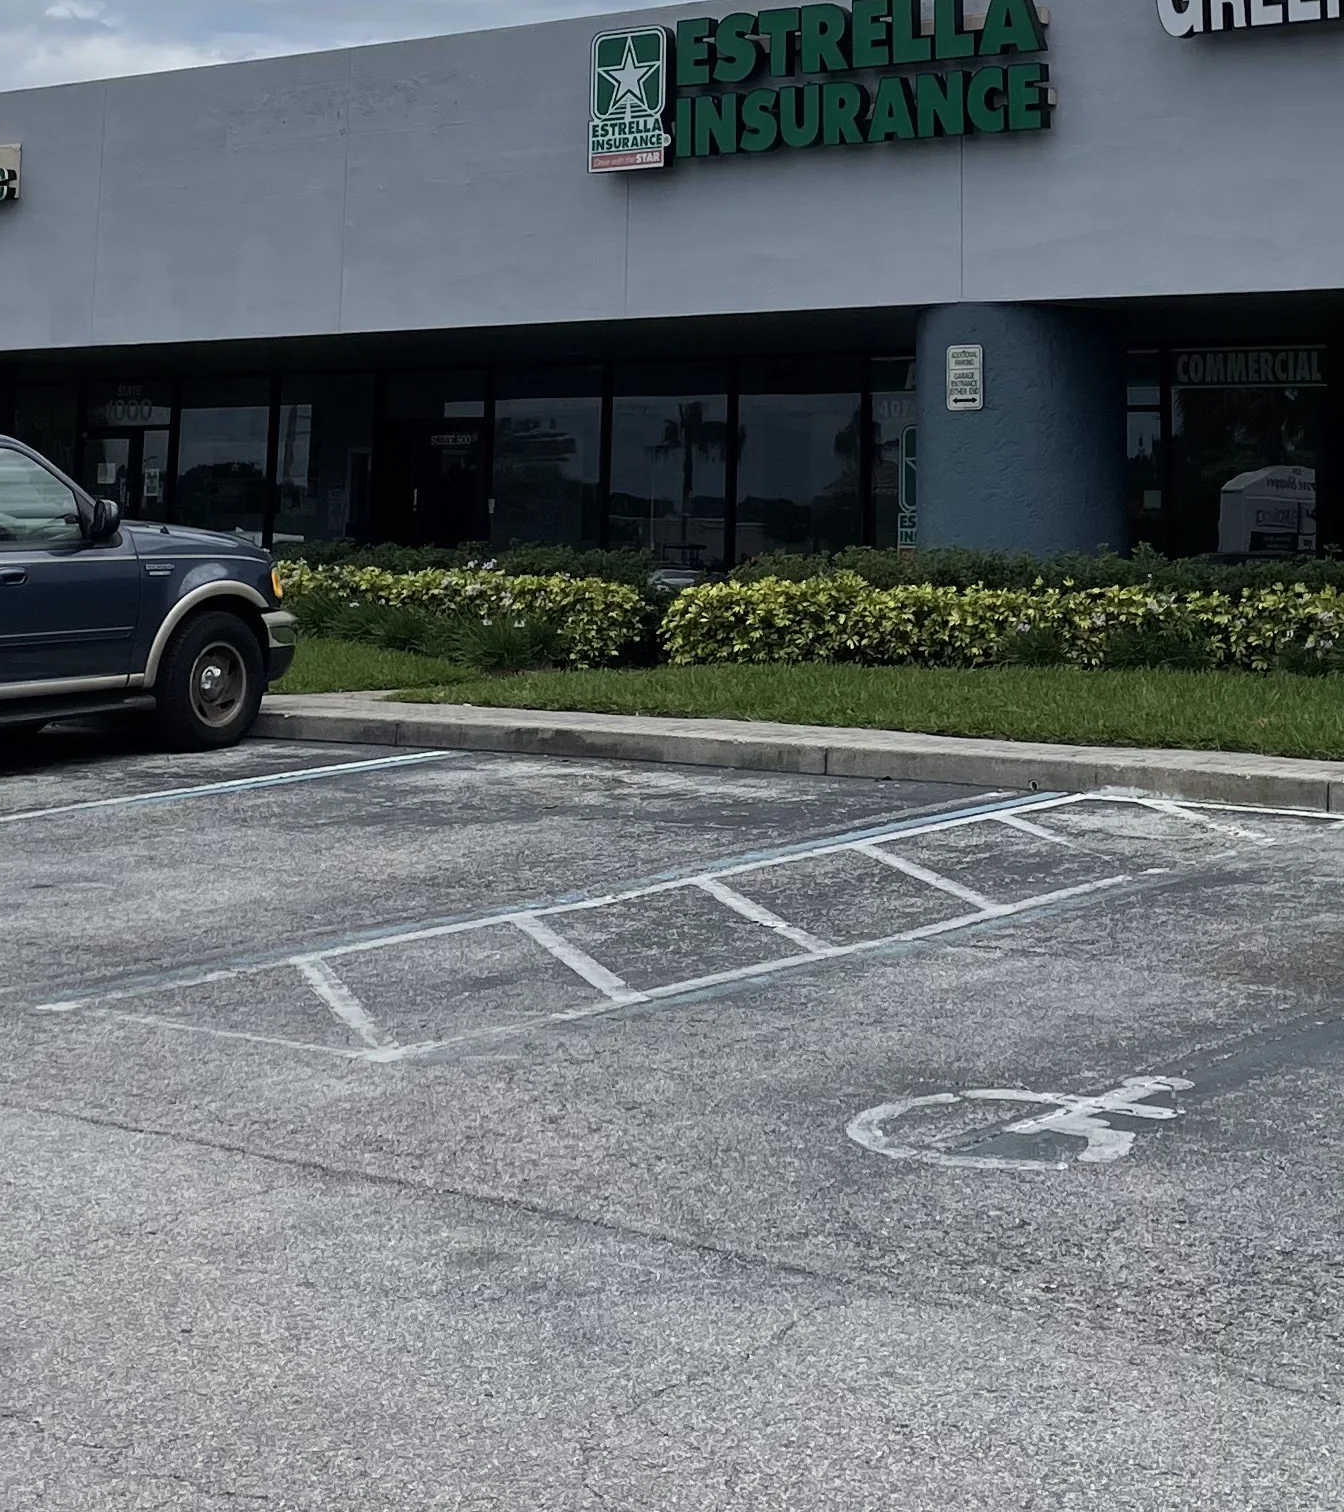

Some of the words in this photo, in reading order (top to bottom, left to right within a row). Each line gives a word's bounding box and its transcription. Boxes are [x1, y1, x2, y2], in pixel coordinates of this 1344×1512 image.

[675, 63, 1045, 158] INSURANCE
[591, 118, 662, 139] ESTRELLA
[591, 133, 663, 152] INSURANCE
[635, 151, 660, 164] STAR
[1176, 350, 1322, 384] COMMERCIAL
[116, 384, 143, 397] SUITE
[430, 434, 455, 446] SUITE
